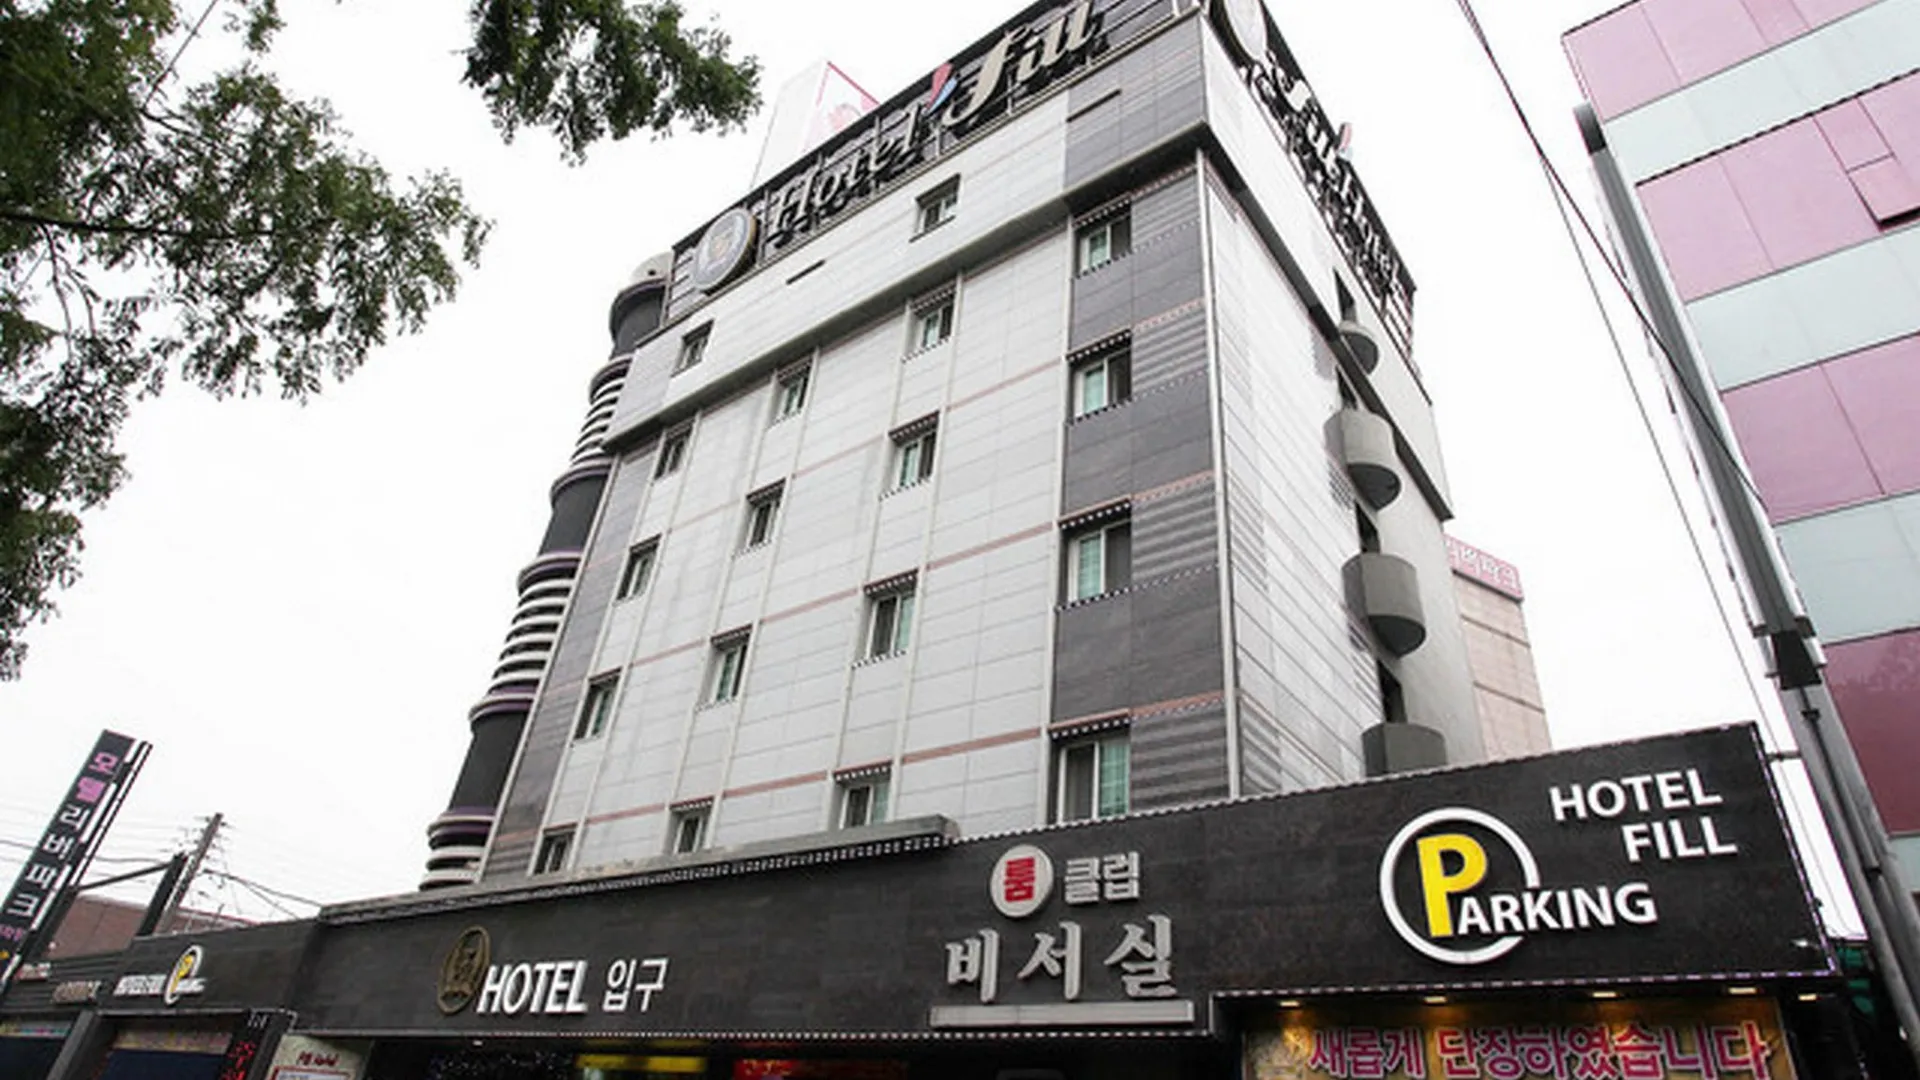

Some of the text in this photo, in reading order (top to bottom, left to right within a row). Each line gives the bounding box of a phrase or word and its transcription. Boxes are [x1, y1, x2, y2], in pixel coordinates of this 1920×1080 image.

[771, 102, 921, 232] Hotel
[1549, 767, 1723, 822] HOTEL
[1621, 815, 1738, 864] FILL
[1004, 851, 1141, 905] 룸 클럽
[1416, 833, 1658, 939] PARKING
[476, 958, 668, 1014] HOTEL 입구
[945, 914, 1178, 1002] 비서실
[1308, 1020, 1772, 1080] 새롭게 단장하였습니다
